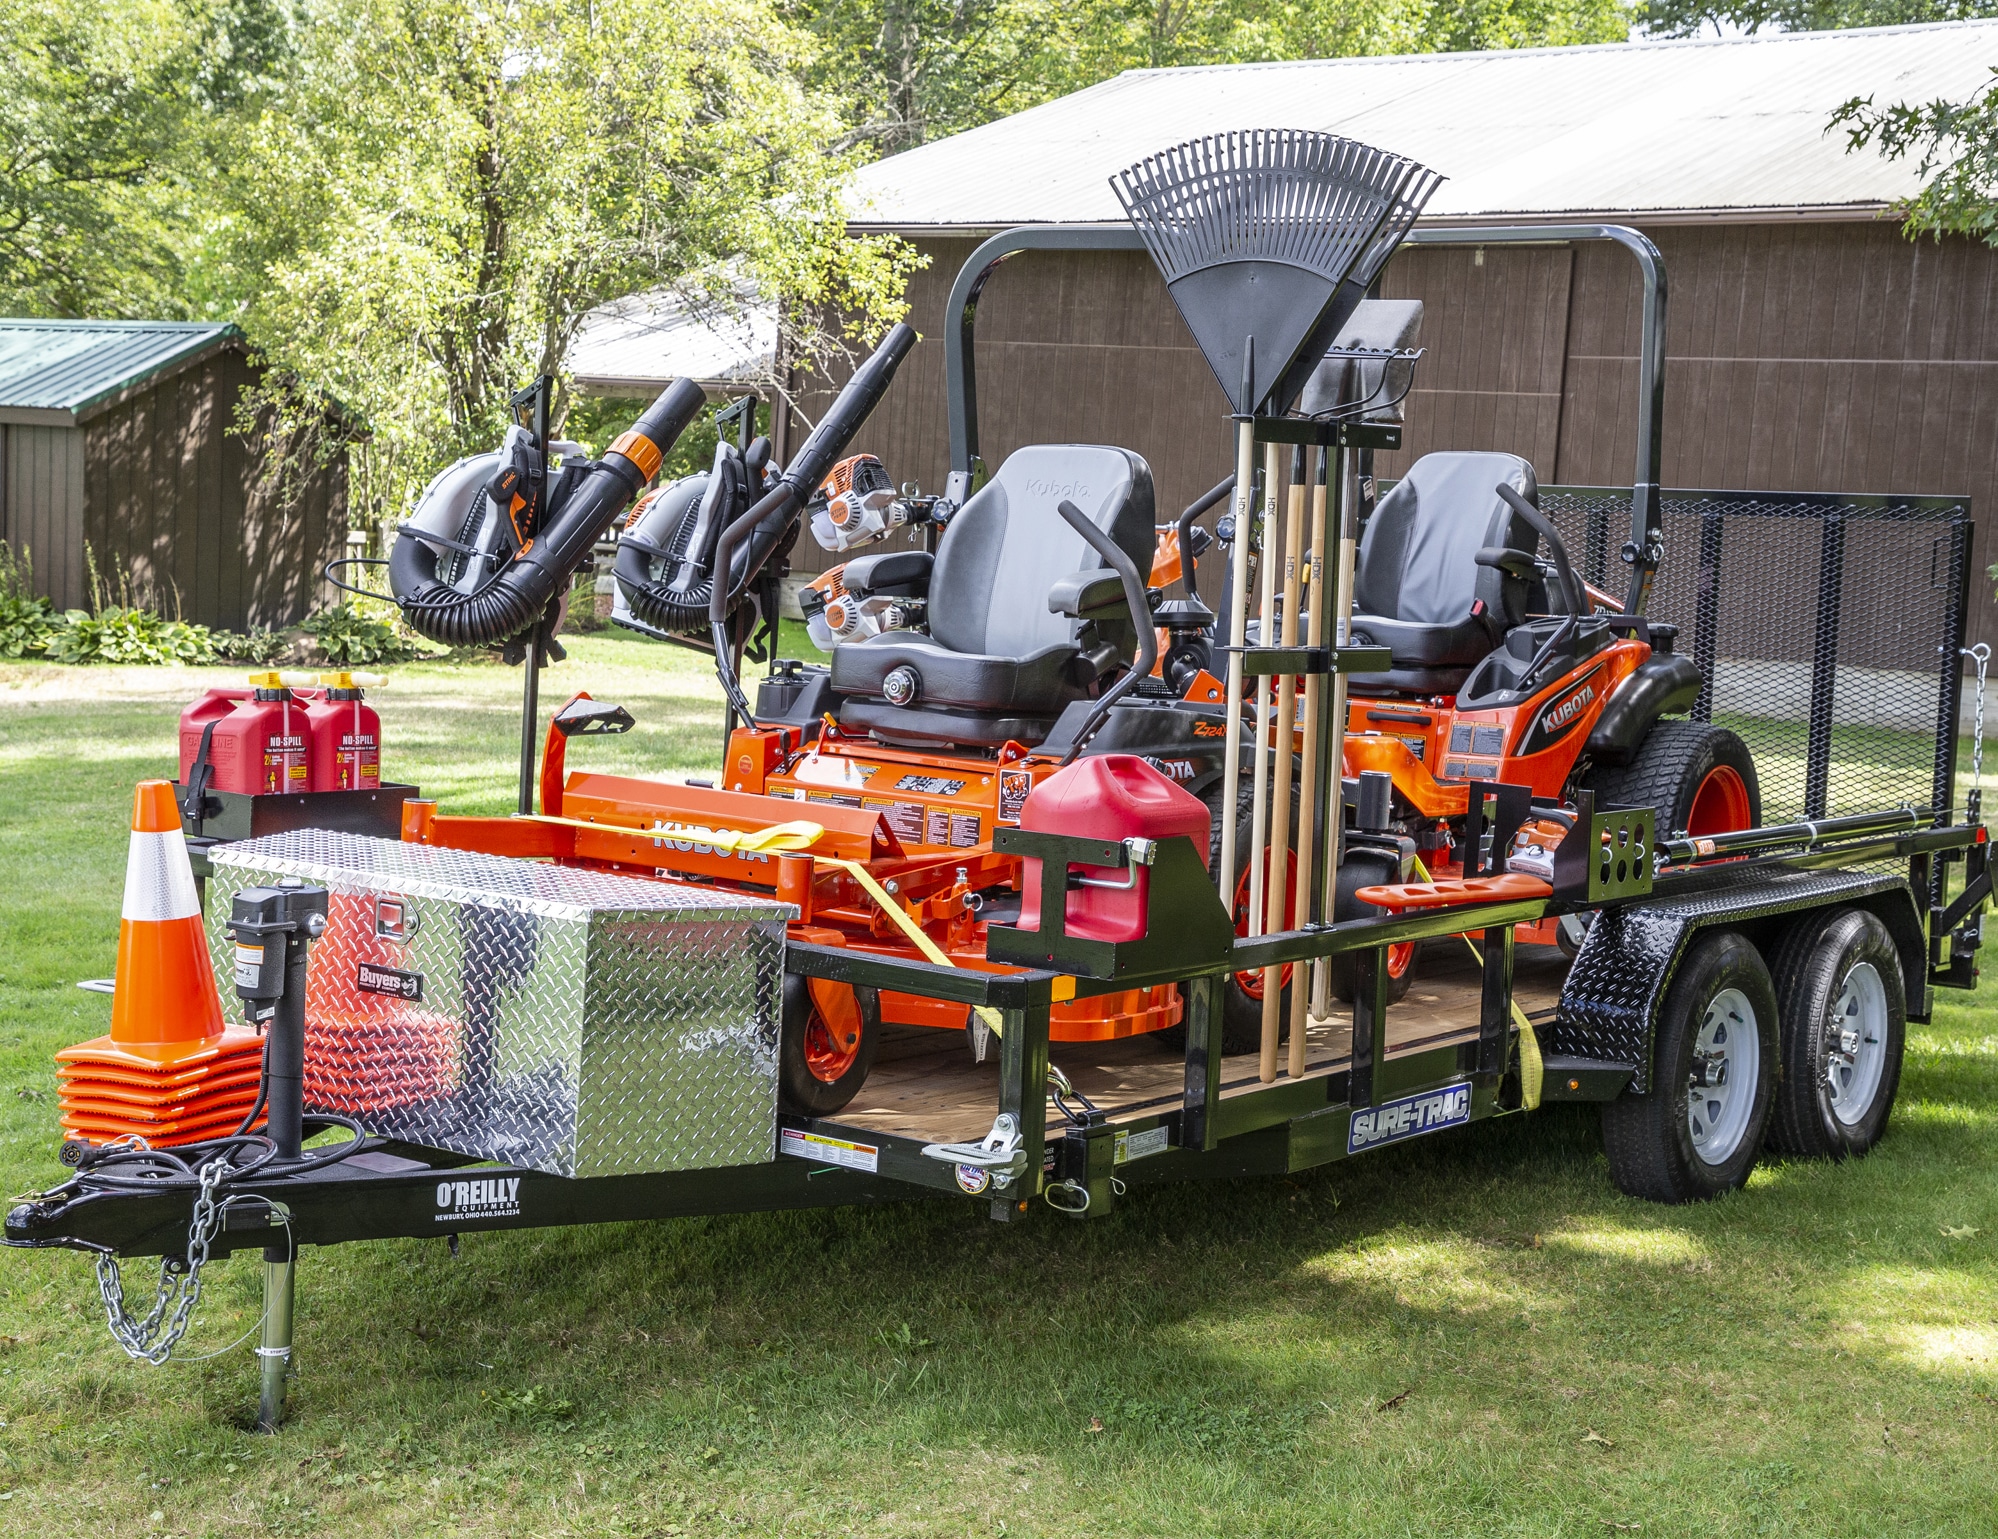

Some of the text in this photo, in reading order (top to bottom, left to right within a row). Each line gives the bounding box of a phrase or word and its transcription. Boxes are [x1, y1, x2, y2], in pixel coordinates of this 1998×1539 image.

[501, 471, 516, 490] STIHL
[1026, 479, 1088, 498] Kubota
[1238, 496, 1246, 516] HDX
[1267, 496, 1276, 516] HDX
[1286, 556, 1295, 581] HDX
[1311, 556, 1321, 581] HDX
[1541, 684, 1595, 734] KUBOTA
[187, 736, 233, 749] GALINE
[270, 736, 302, 747] NO-SPILL
[342, 735, 374, 745] NO-SPILL
[360, 966, 401, 989] Buyers
[1352, 1089, 1468, 1146] SURE-TRAC
[436, 1178, 520, 1208] O'REILLY
[434, 1212, 464, 1221] NEWBURY,
[465, 1210, 480, 1219] OHIO
[454, 1201, 520, 1213] EQUIPMENT
